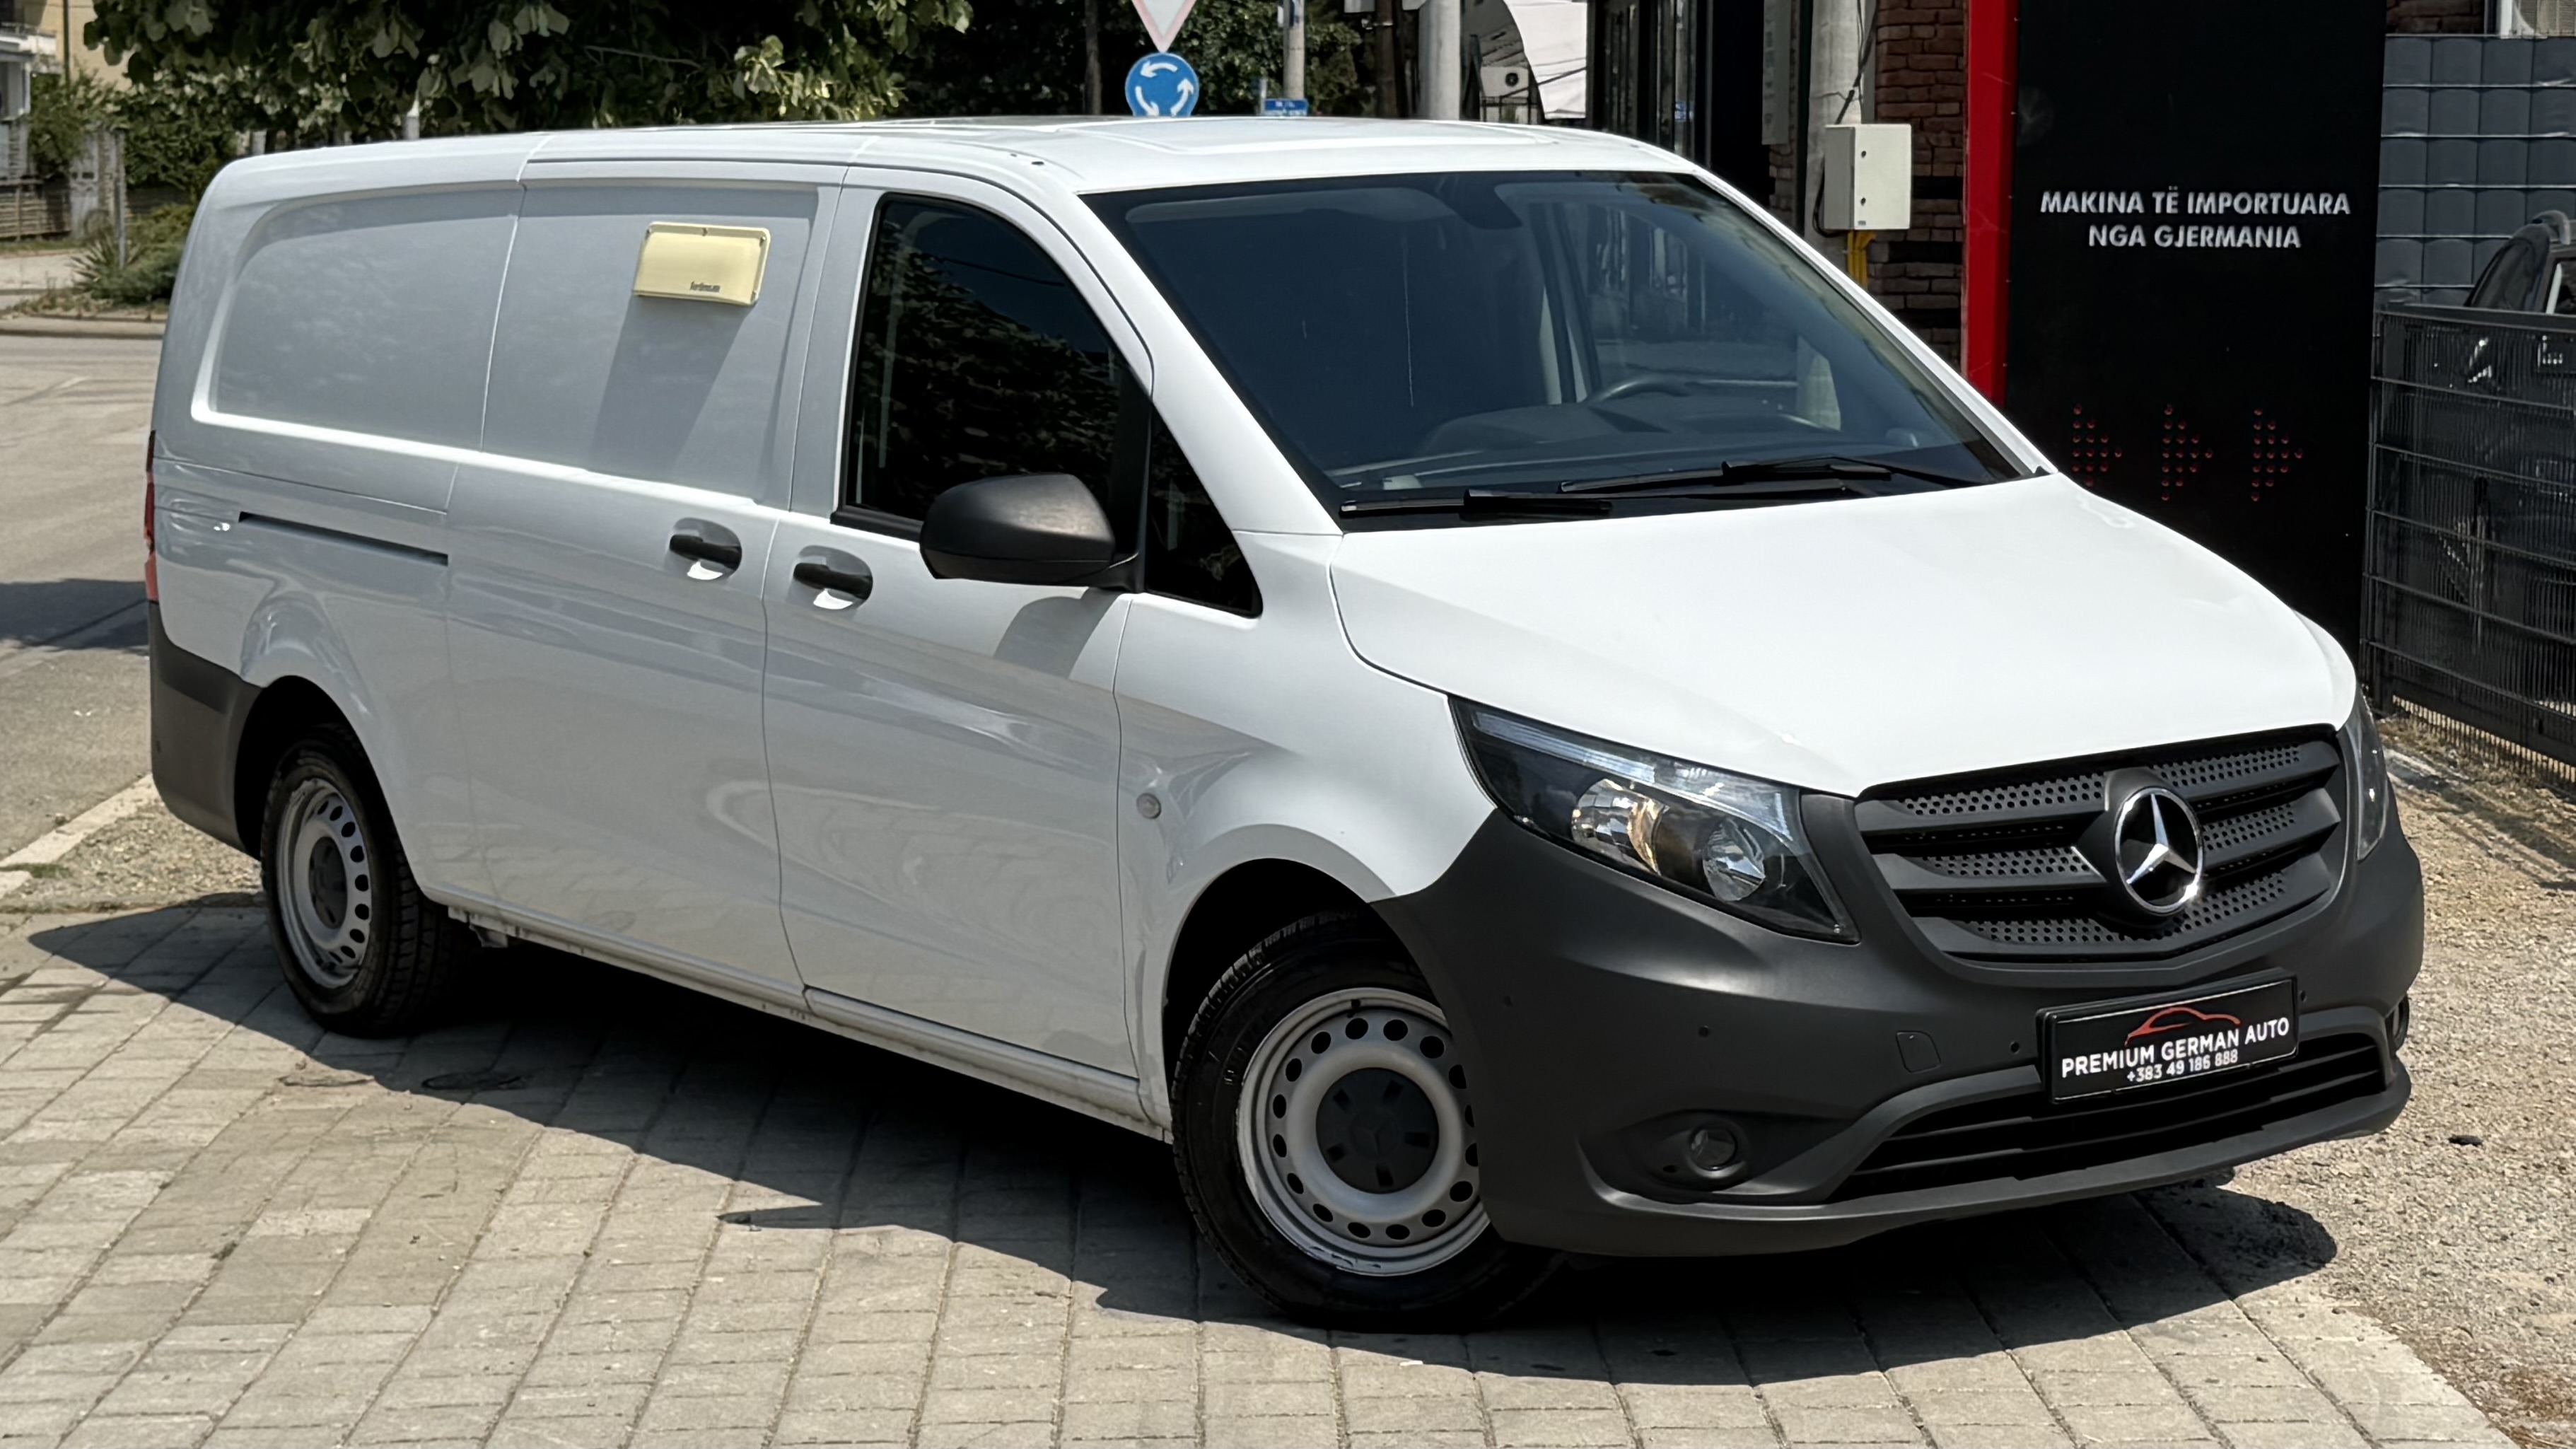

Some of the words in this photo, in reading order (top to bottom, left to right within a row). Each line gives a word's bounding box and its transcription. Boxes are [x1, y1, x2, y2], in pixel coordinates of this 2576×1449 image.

[2040, 191, 2145, 214] MAKINA
[2152, 186, 2179, 214] TË
[2187, 192, 2350, 215] IMPORTUARA
[2088, 225, 2146, 248] NGA
[2154, 225, 2301, 248] GJERMANIA
[2061, 1044, 2155, 1078] PREMIUM
[2161, 1028, 2240, 1061] GERMAN
[2244, 1017, 2290, 1044] AUTO
[2126, 1064, 2162, 1083] +383
[2167, 1060, 2184, 1076] 49
[2189, 1054, 2211, 1072] 186
[2215, 1049, 2239, 1066] 888
